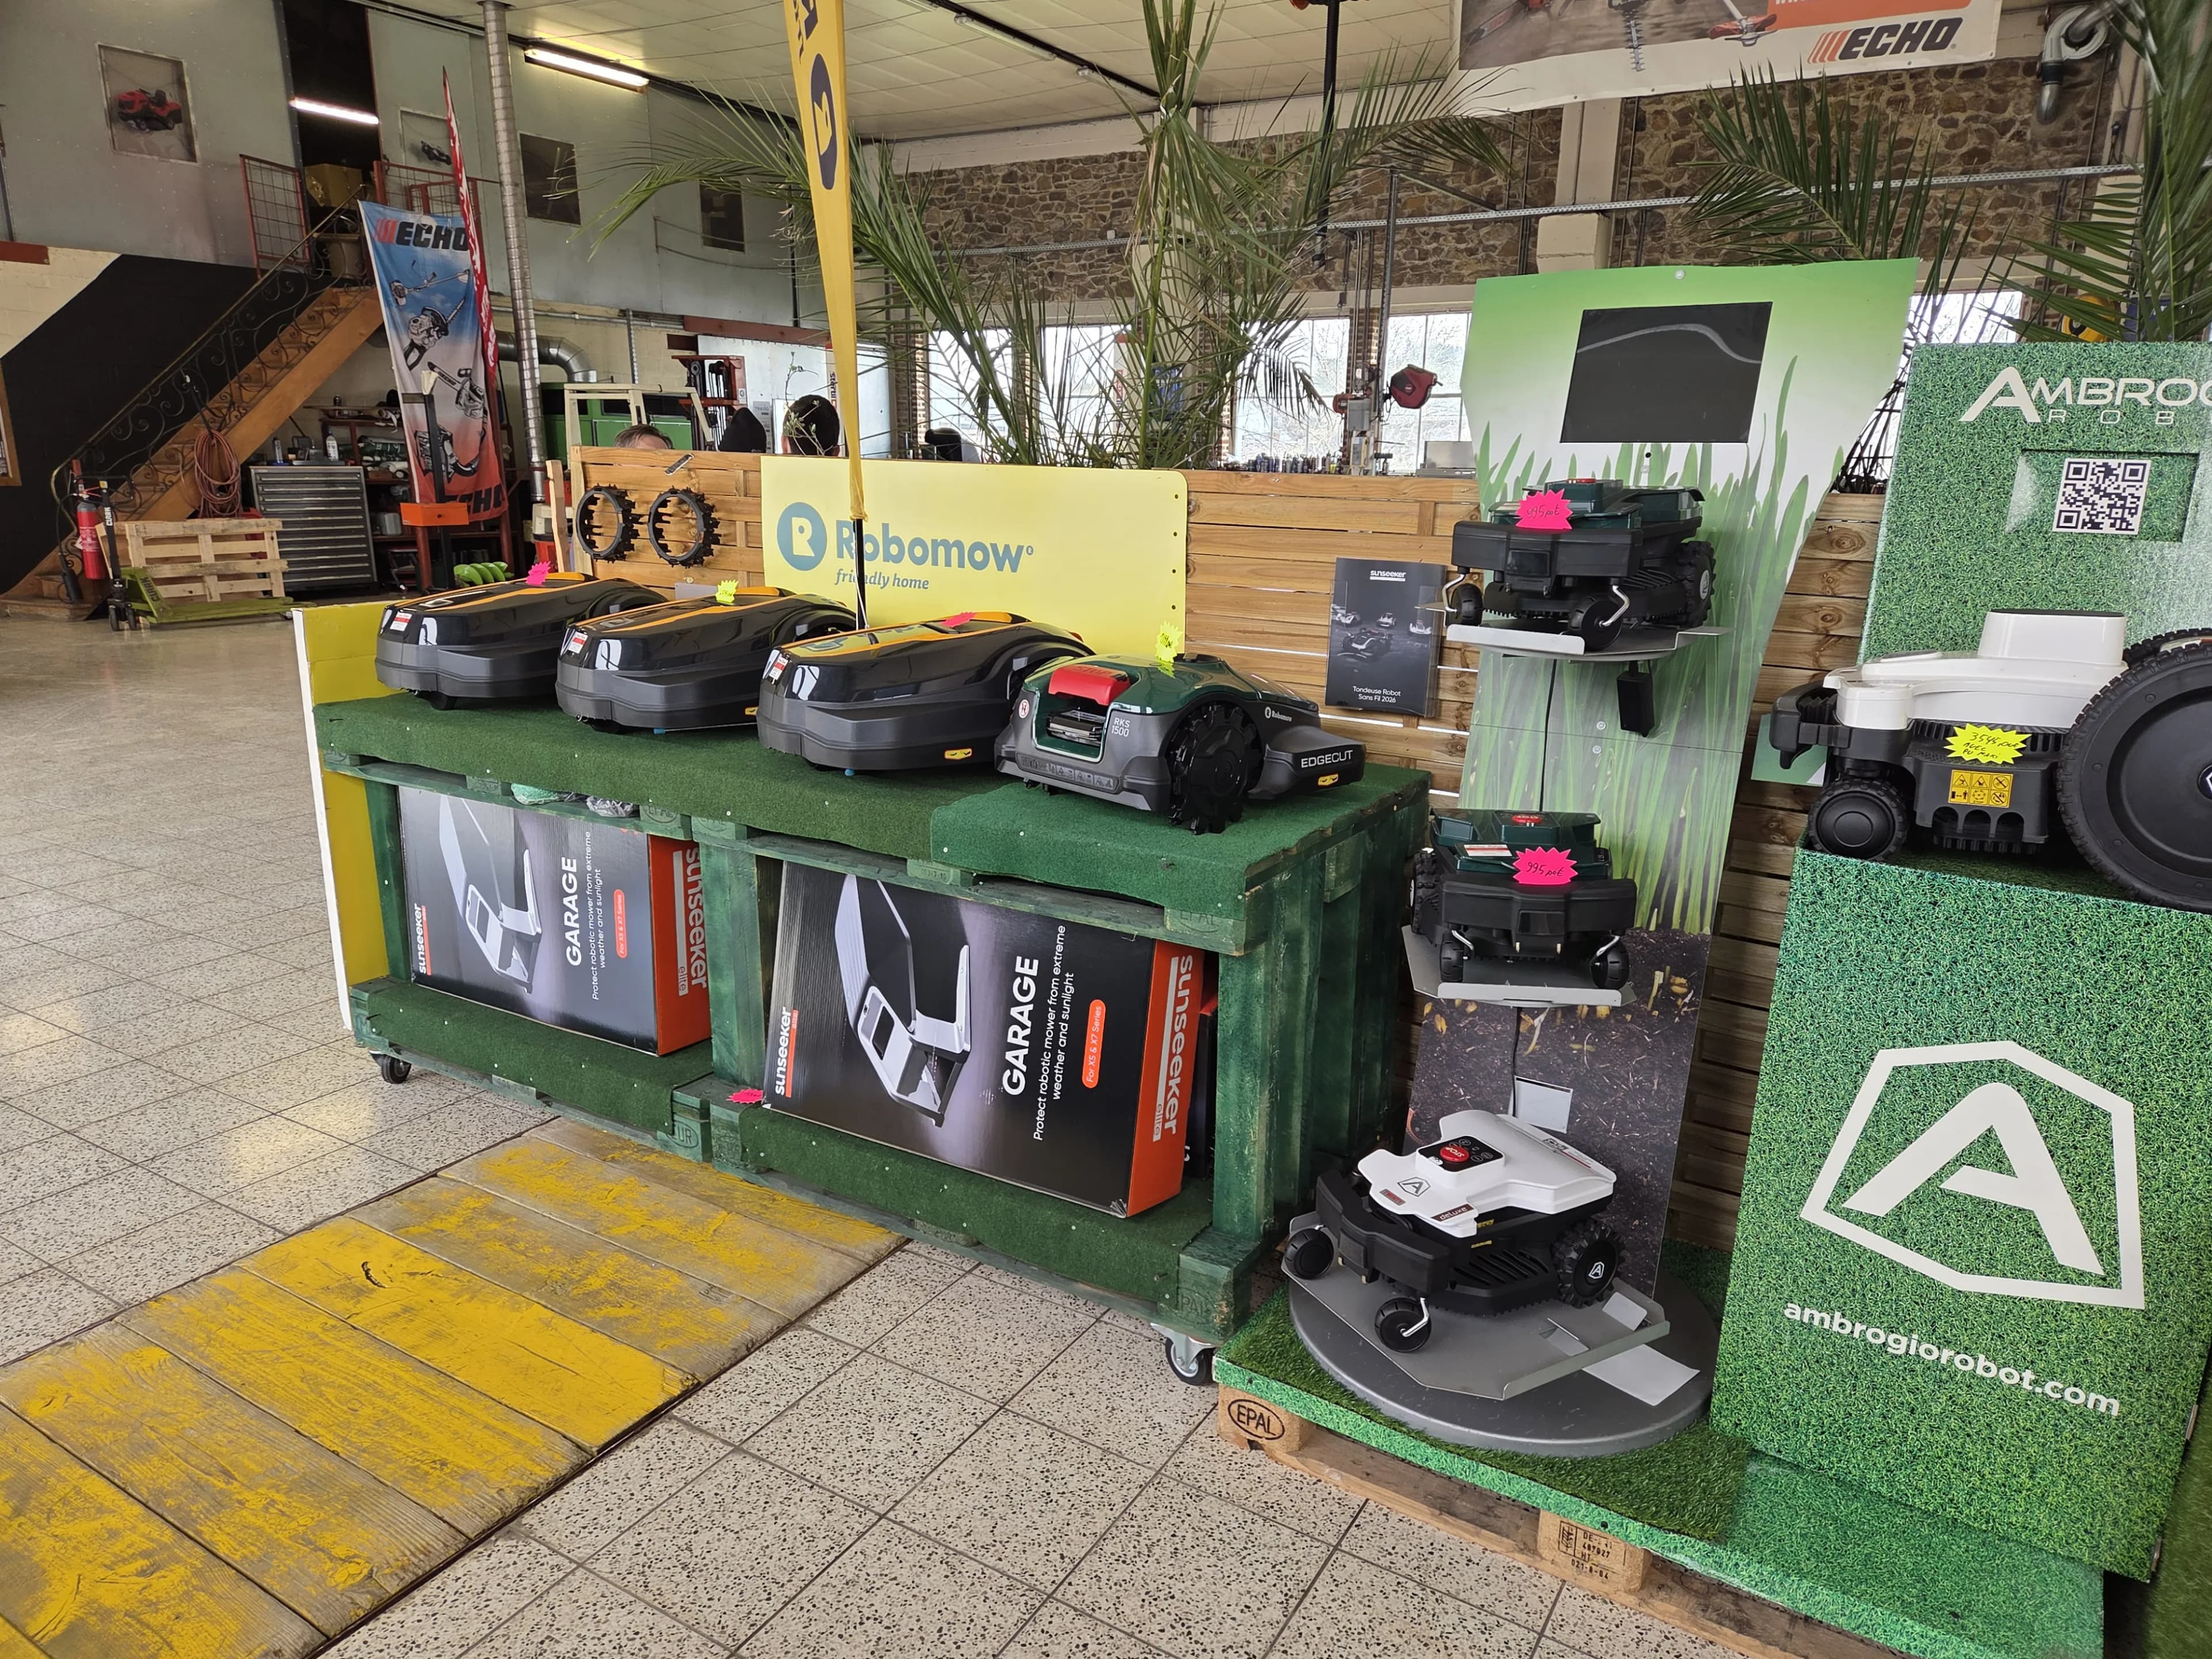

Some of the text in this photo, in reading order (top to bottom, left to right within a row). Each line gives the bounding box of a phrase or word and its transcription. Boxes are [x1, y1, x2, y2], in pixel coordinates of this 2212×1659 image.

[1838, 17, 1963, 60] ECHO
[396, 221, 469, 251] ECHO
[835, 569, 929, 589] frindly home
[1353, 685, 1401, 696] Tondeuse Robot
[1112, 725, 1129, 737] 1500
[1114, 718, 1130, 728] RKS
[1301, 749, 1353, 768] EDGECUT
[561, 857, 582, 966] GARAGE
[594, 869, 605, 968] weather and sunlight
[419, 903, 427, 974] sunseeker
[591, 967, 600, 1000] Protect
[678, 966, 687, 992] elite
[1002, 956, 1039, 1096] GARAGE
[1033, 926, 1066, 1141] Protect robotic mower from extreme
[1092, 1006, 1101, 1032] Series
[775, 1007, 791, 1096] sunseeker
[1052, 972, 1075, 1100] weather and sunlight
[1090, 1034, 1099, 1045] X7
[1165, 955, 1194, 1135] sunseeker
[1086, 1068, 1096, 1082] For
[1088, 1055, 1097, 1066] X5
[1153, 1103, 1163, 1136] elite
[1445, 1146, 1465, 1157] STOP
[1440, 1206, 1467, 1220] deluxe
[1783, 1301, 2120, 1416] ambrogiorobot.com
[1237, 1404, 1276, 1436] EPAL
